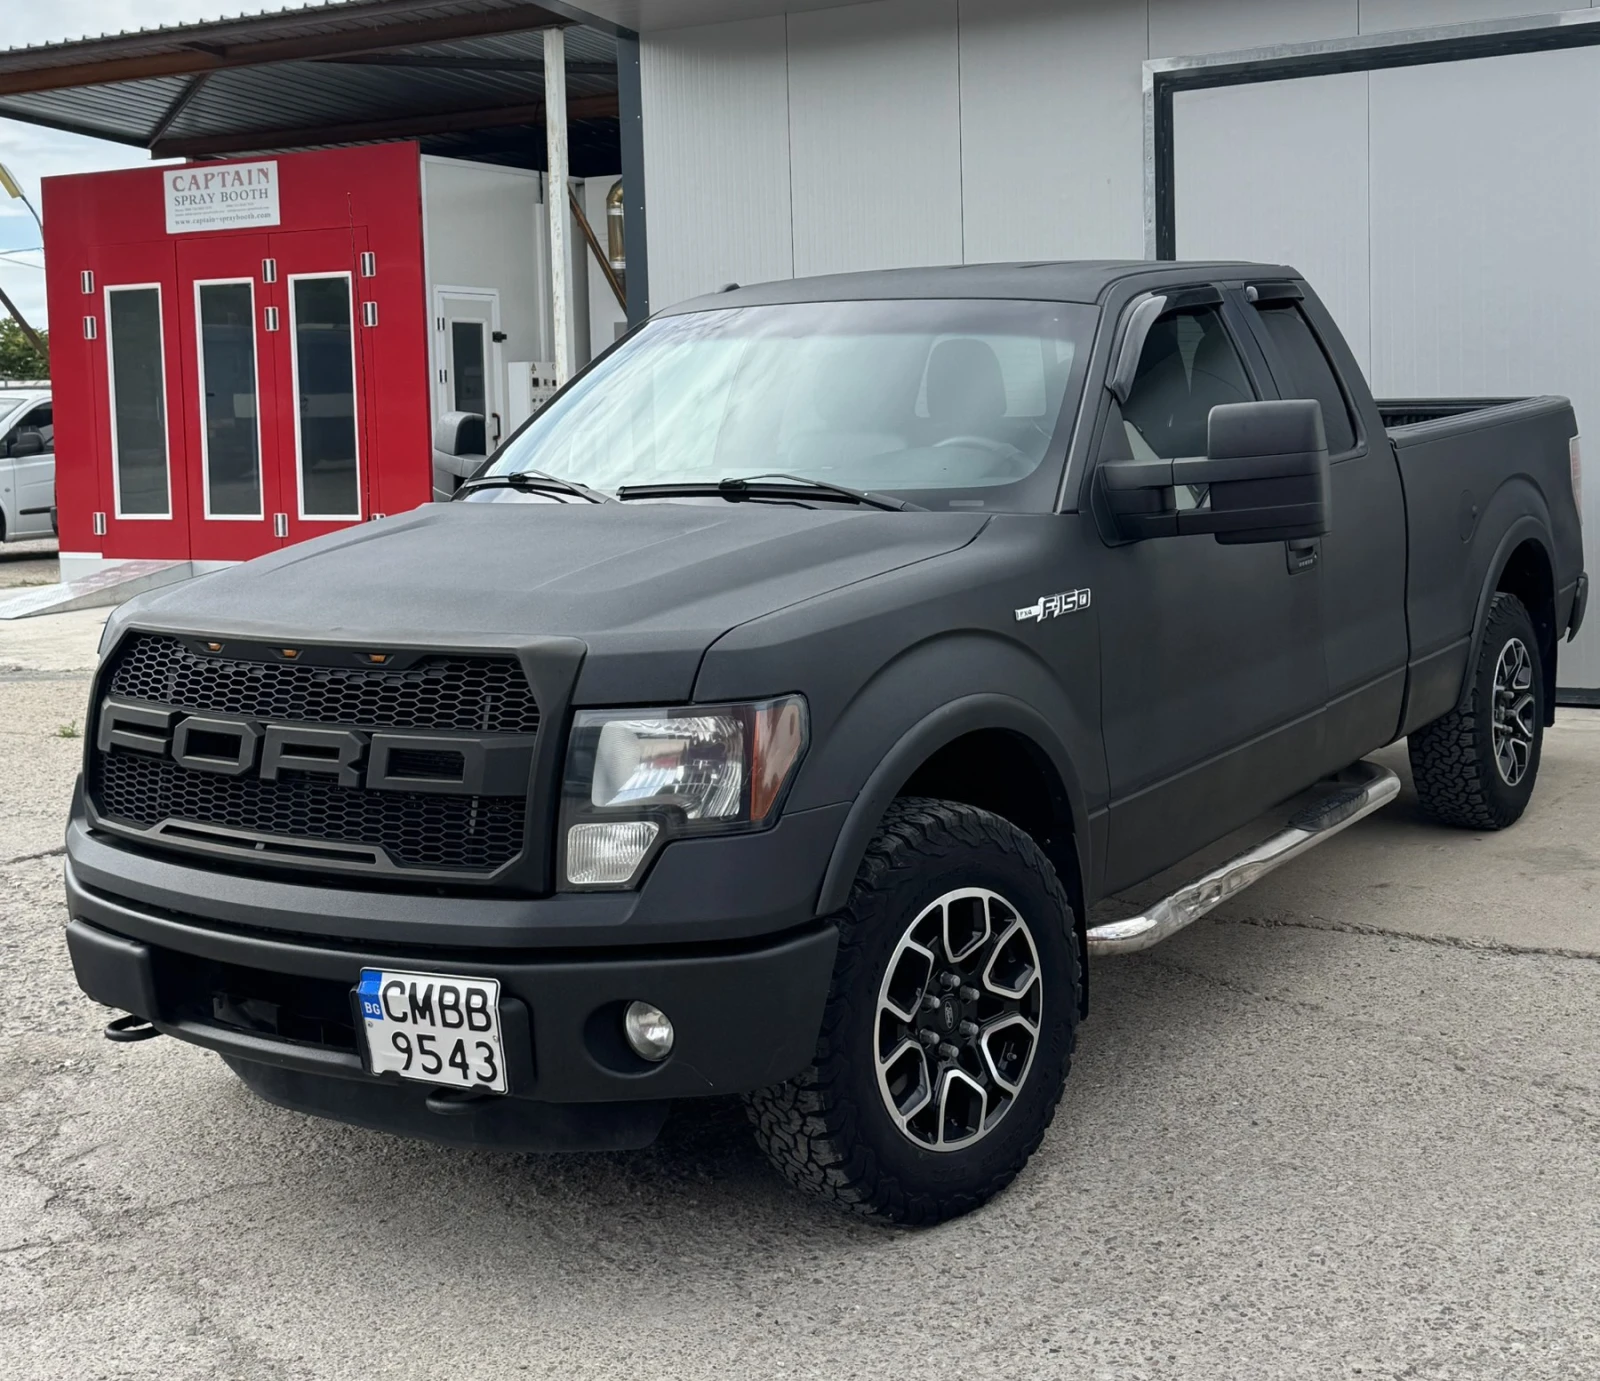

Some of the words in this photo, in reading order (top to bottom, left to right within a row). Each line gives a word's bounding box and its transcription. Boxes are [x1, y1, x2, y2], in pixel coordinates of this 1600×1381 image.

[172, 167, 270, 192] CAPTAIN
[174, 193, 215, 206] SPRAY
[220, 188, 268, 202] BOOTH
[97, 698, 490, 796] FORD
[364, 1001, 381, 1015] BG
[382, 980, 492, 1032] CMBB
[391, 1031, 497, 1083] 9543
